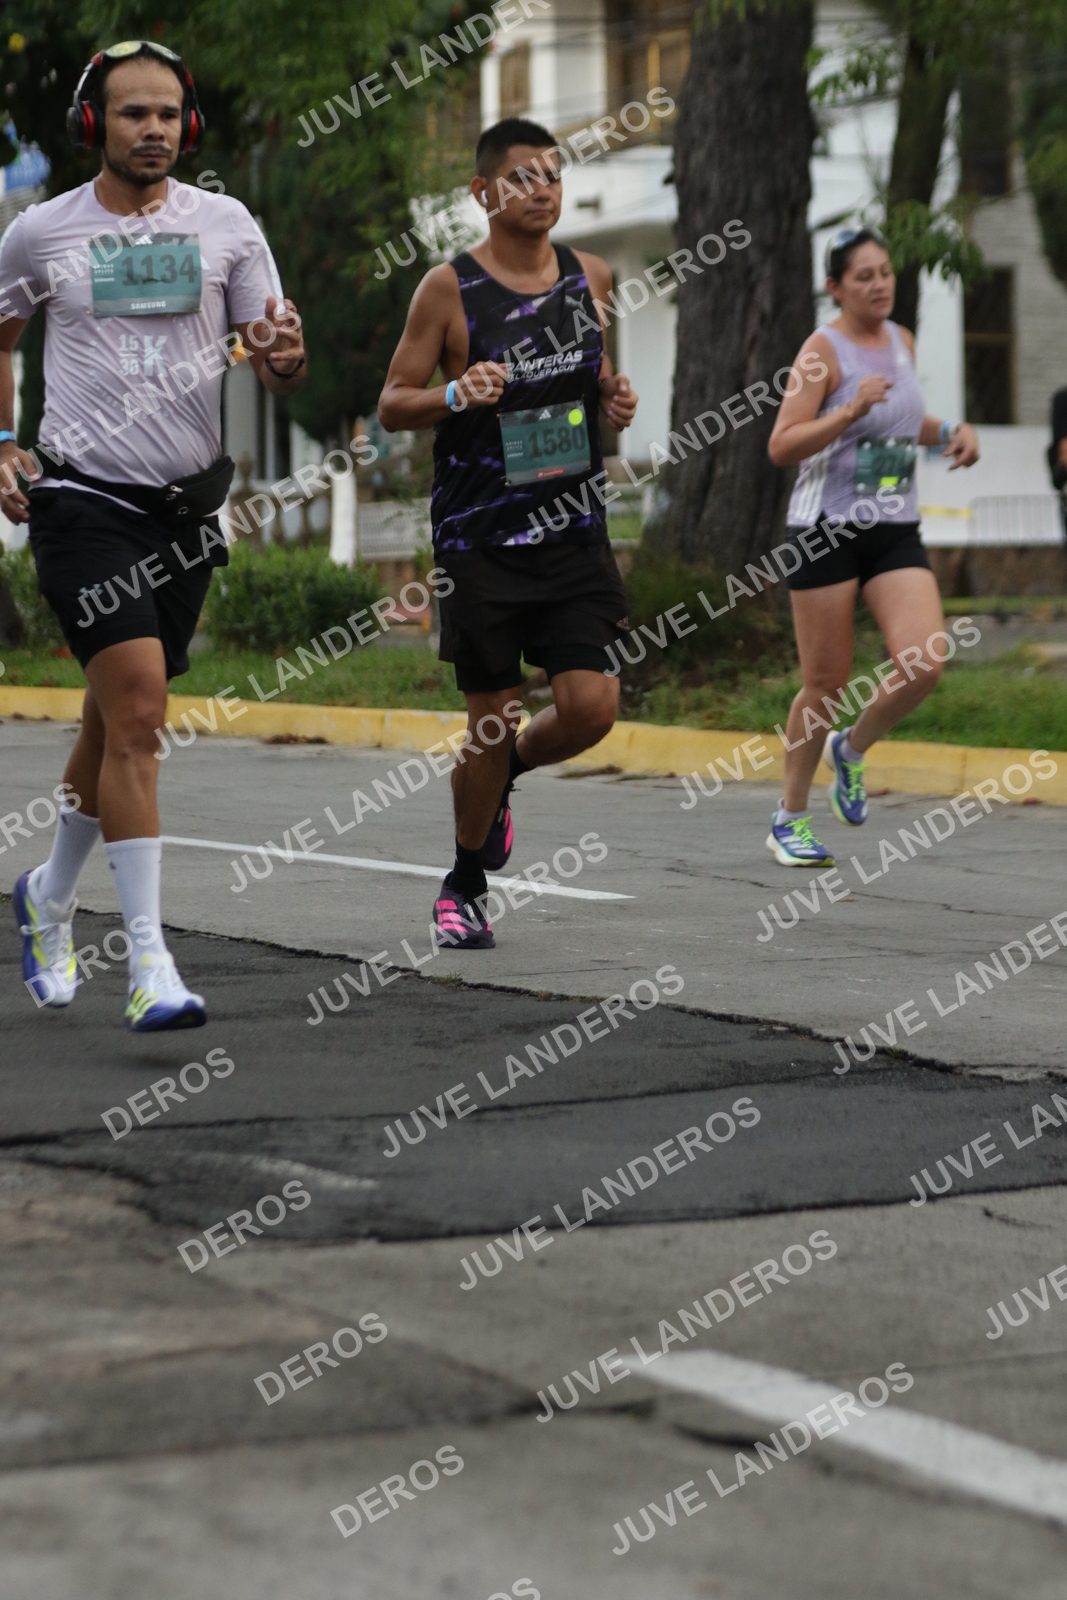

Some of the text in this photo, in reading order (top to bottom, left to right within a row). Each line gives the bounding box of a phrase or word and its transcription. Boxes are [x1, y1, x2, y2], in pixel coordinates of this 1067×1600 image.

[121, 253, 198, 286] 1134
[119, 334, 139, 351] 15
[143, 335, 169, 377] K
[528, 426, 586, 458] 1580
